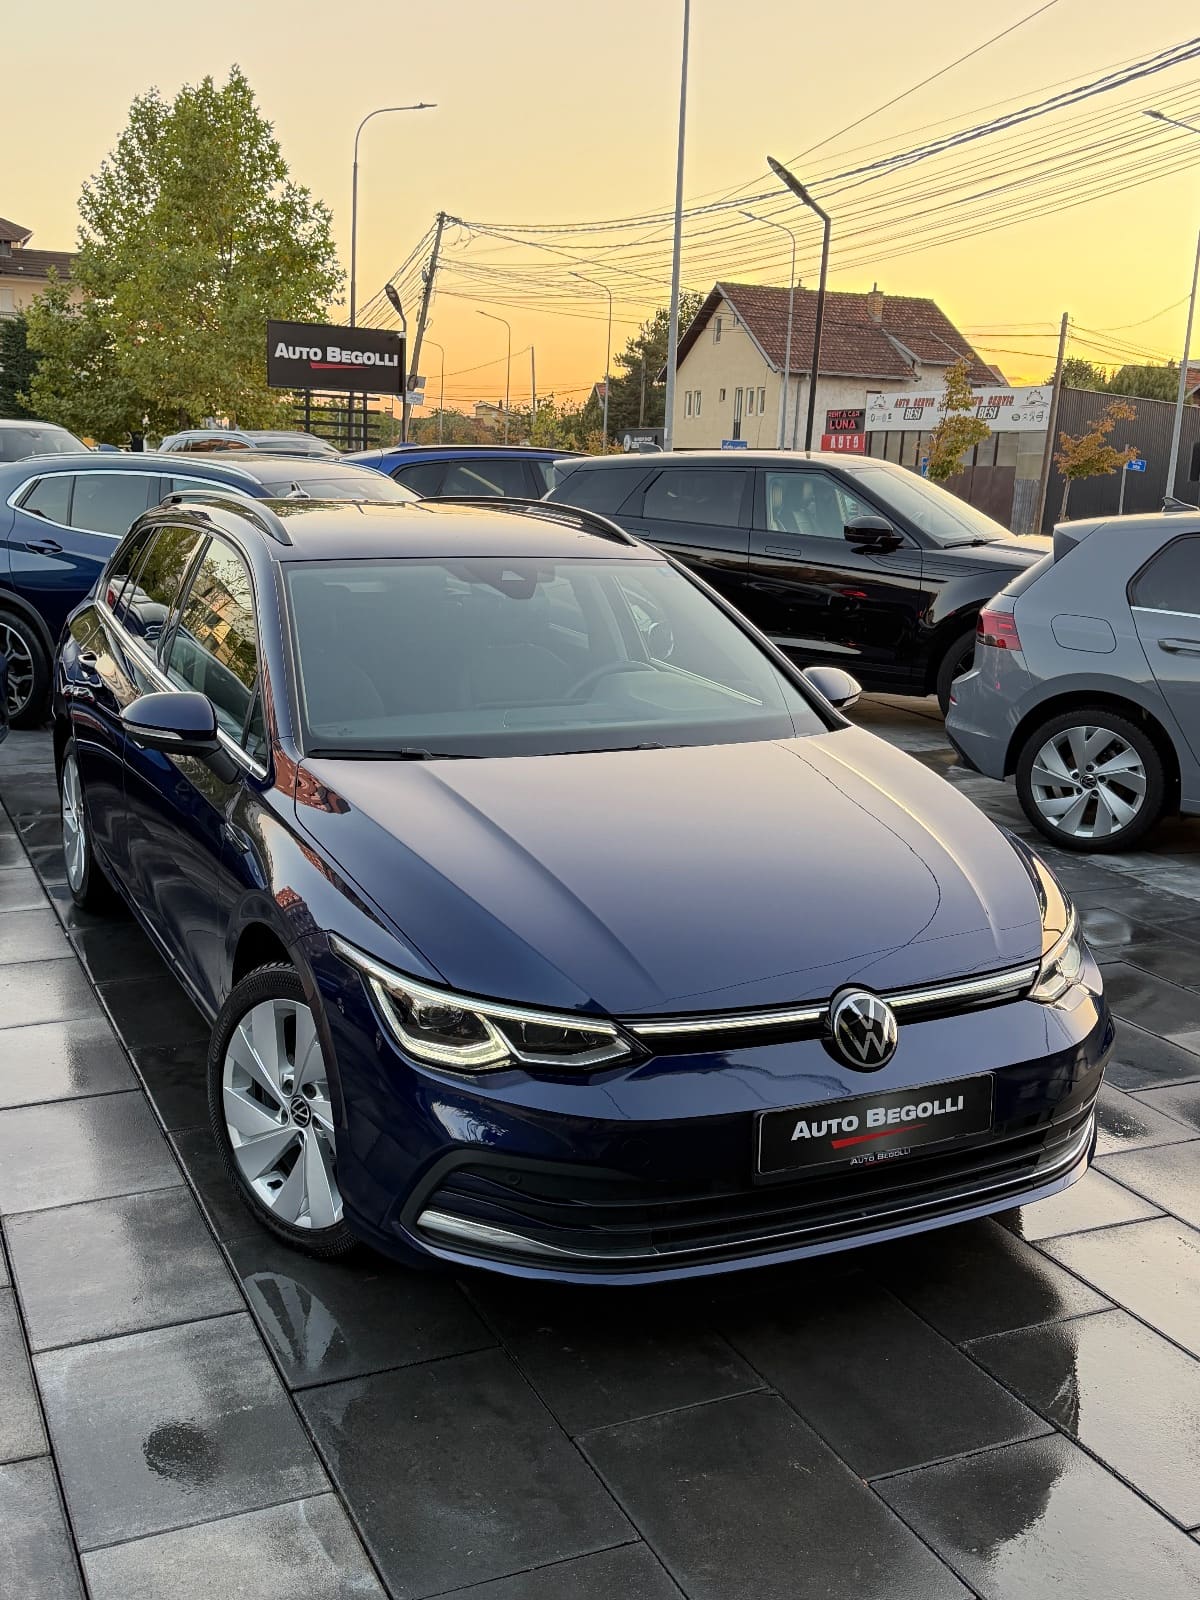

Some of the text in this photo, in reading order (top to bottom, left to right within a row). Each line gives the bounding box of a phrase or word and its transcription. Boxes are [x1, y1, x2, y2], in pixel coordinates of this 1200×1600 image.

[274, 342, 399, 367] AUTO BEGOLLI
[905, 408, 921, 419] BESI
[977, 406, 998, 419] BESI
[829, 419, 856, 430] LUNA
[830, 435, 859, 449] AUTO
[790, 1095, 964, 1142] AUTO BEGOLLI
[850, 1147, 911, 1166] AUTO BEGOLLI
